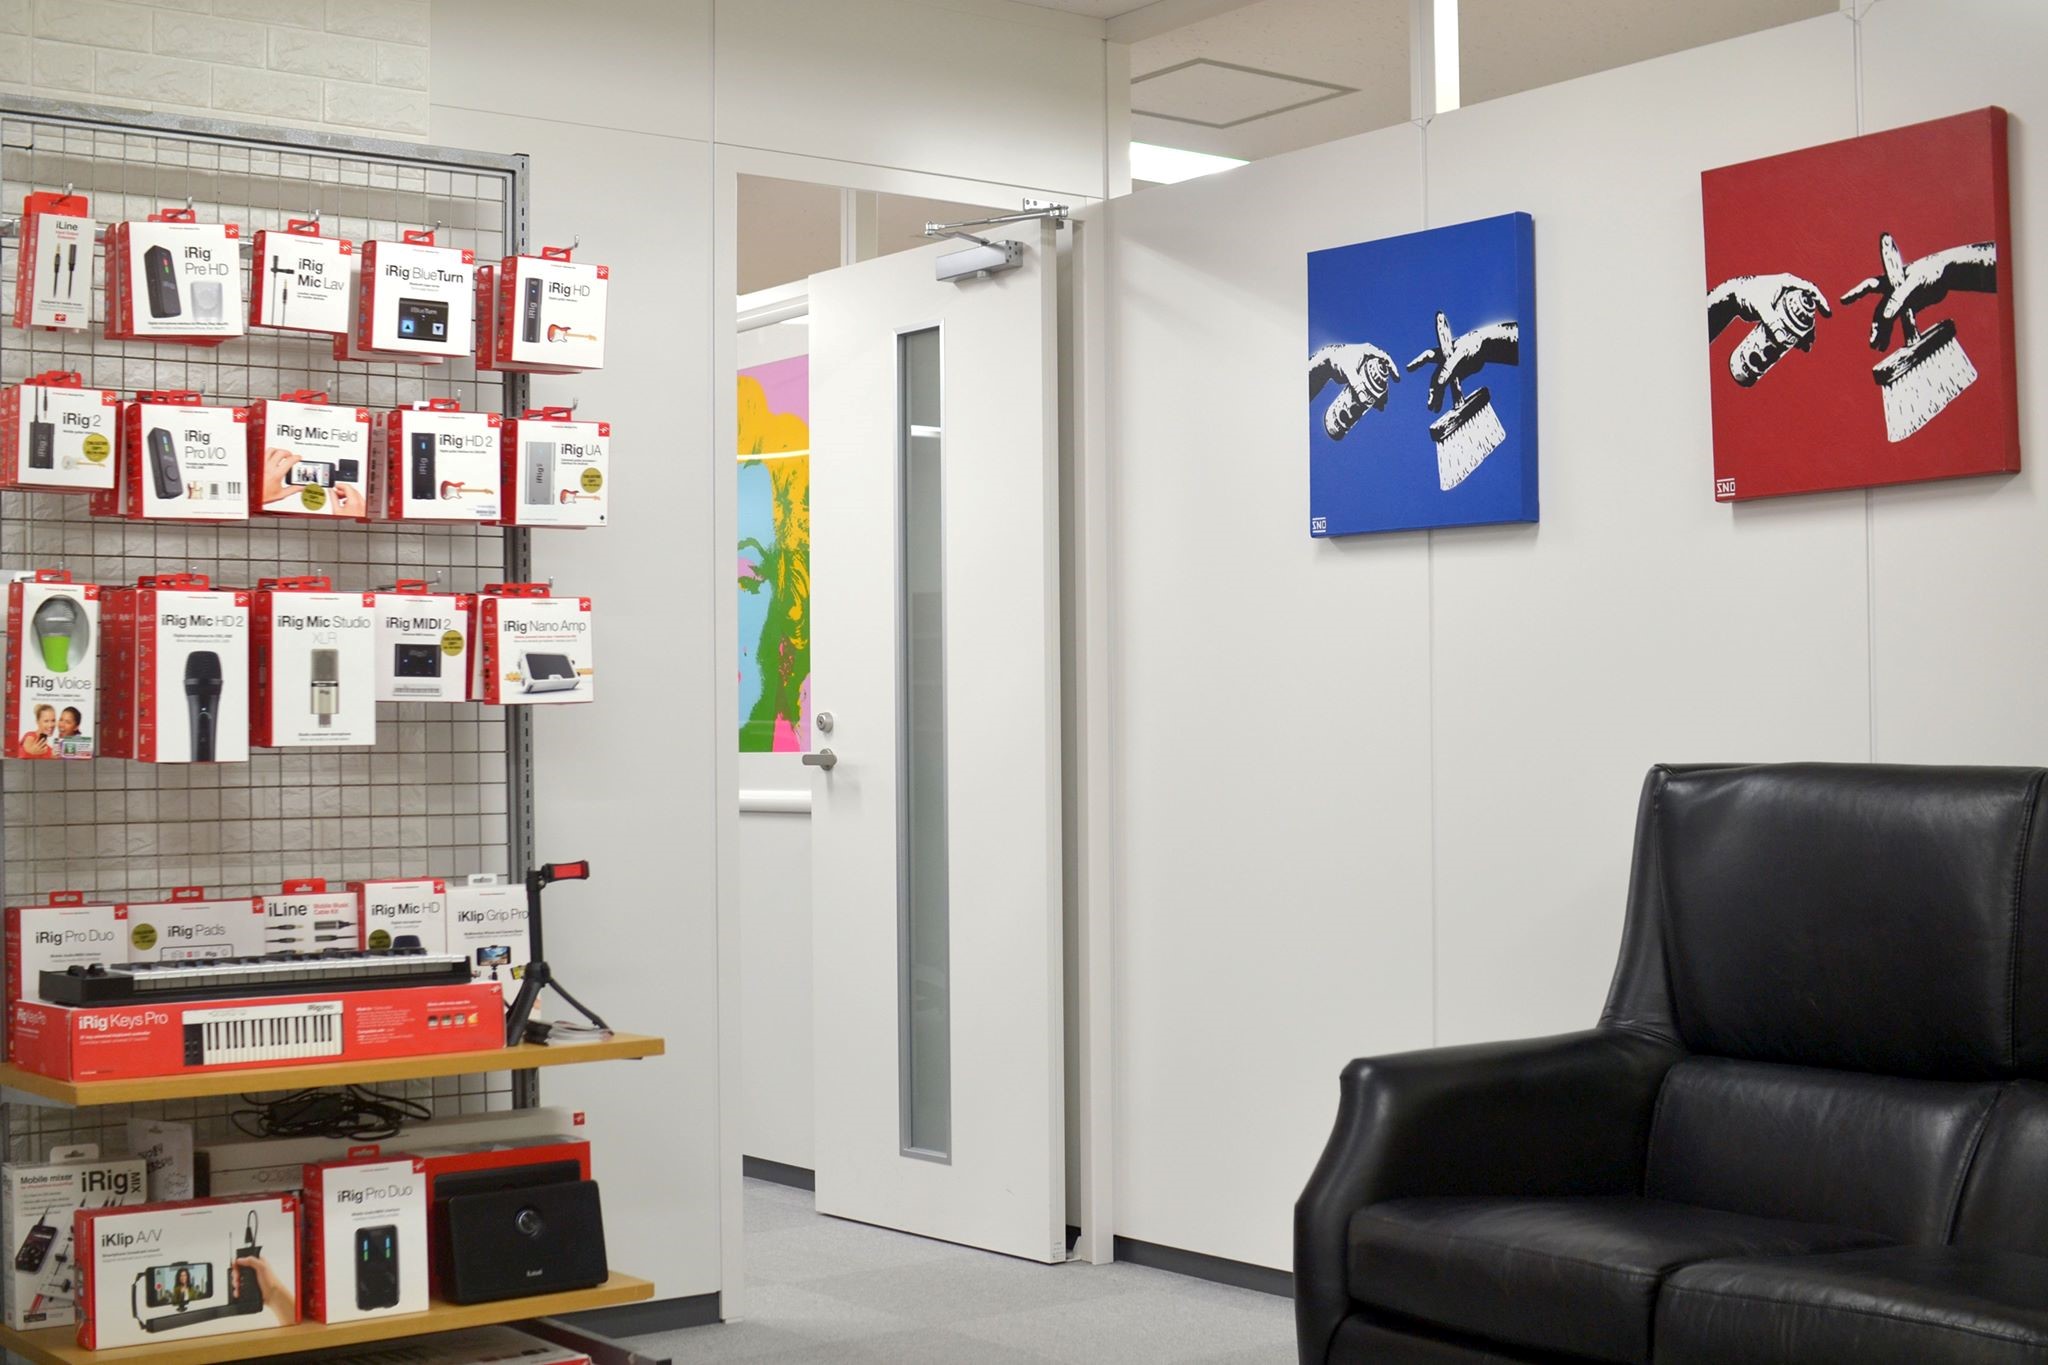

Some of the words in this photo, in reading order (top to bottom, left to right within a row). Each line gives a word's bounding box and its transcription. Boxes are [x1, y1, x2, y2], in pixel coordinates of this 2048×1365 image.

[55, 220, 79, 232] iLine
[184, 246, 212, 262] iRig
[185, 262, 207, 275] Pre
[208, 262, 229, 276] HD
[298, 258, 323, 275] iRig
[385, 264, 410, 281] iRig
[412, 267, 464, 284] BlueTurn
[297, 274, 321, 288] Mic
[323, 276, 344, 292] Lav
[548, 282, 572, 297] iRig
[573, 283, 590, 297] HD
[63, 413, 91, 428] iRig
[92, 414, 101, 427] 2
[184, 429, 211, 445] iRig
[277, 424, 304, 440] iRig
[305, 425, 329, 439] Mic
[330, 427, 358, 443] Field
[439, 433, 464, 449] iRig
[465, 434, 484, 448] HD
[485, 435, 493, 448] 2
[185, 445, 207, 459] Pro
[208, 446, 227, 460] I/O
[561, 443, 584, 458] iRig
[585, 444, 603, 456] UA
[161, 614, 188, 628] iRig
[189, 614, 213, 626] Mic
[215, 615, 234, 626] HD
[277, 615, 304, 630] iRig
[305, 616, 330, 628] Mic
[332, 616, 371, 629] Studio
[386, 617, 411, 631] iRig
[412, 617, 442, 630] MIDI
[443, 618, 451, 630] 2
[503, 620, 528, 633] iRig
[529, 621, 559, 632] Nano
[560, 621, 586, 634] Amp
[312, 631, 338, 644] XLR
[25, 676, 54, 691] iRig
[55, 678, 92, 690] Voice
[268, 903, 308, 918] iLine
[371, 904, 396, 918] iRig
[398, 903, 420, 914] Mic
[421, 902, 440, 914] HD
[458, 910, 485, 923] iKlip
[486, 909, 509, 923] Grip
[510, 908, 529, 920] Pro
[35, 931, 63, 946] iRig
[65, 930, 87, 942] Pro
[89, 929, 114, 942] Duo
[167, 925, 193, 939] iRig
[195, 923, 226, 936] Pads
[79, 1015, 108, 1032] iRig
[110, 1013, 143, 1029] Keys
[144, 1011, 169, 1026] Pro
[20, 1176, 48, 1185] Mobile
[50, 1173, 74, 1182] mixer
[81, 1169, 129, 1195] iRig
[129, 1171, 142, 1194] MIX
[337, 1188, 363, 1204] iRig
[365, 1186, 386, 1200] Pro
[387, 1185, 413, 1199] Duo
[101, 1233, 134, 1249] iKlip
[135, 1228, 163, 1243] A/V
